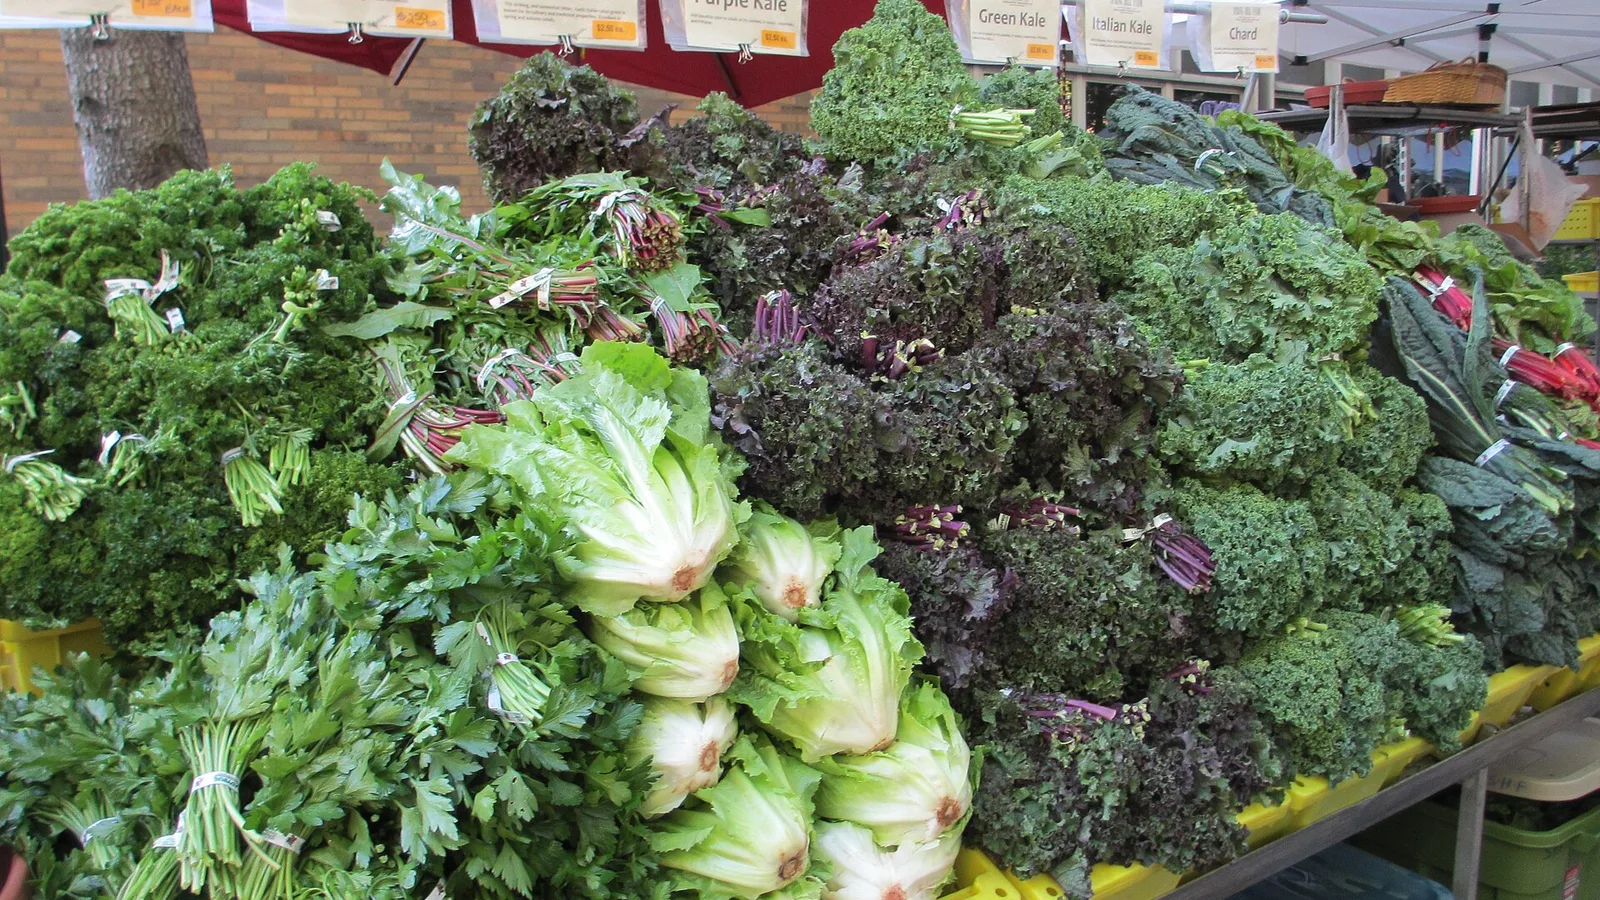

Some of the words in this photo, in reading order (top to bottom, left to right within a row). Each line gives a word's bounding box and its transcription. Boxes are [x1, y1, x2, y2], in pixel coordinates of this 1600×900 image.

[979, 8, 1016, 25] Green
[1020, 12, 1046, 27] Kale
[1092, 16, 1126, 33] Italian
[1129, 19, 1153, 35] Kale
[1229, 26, 1258, 40] Chard
